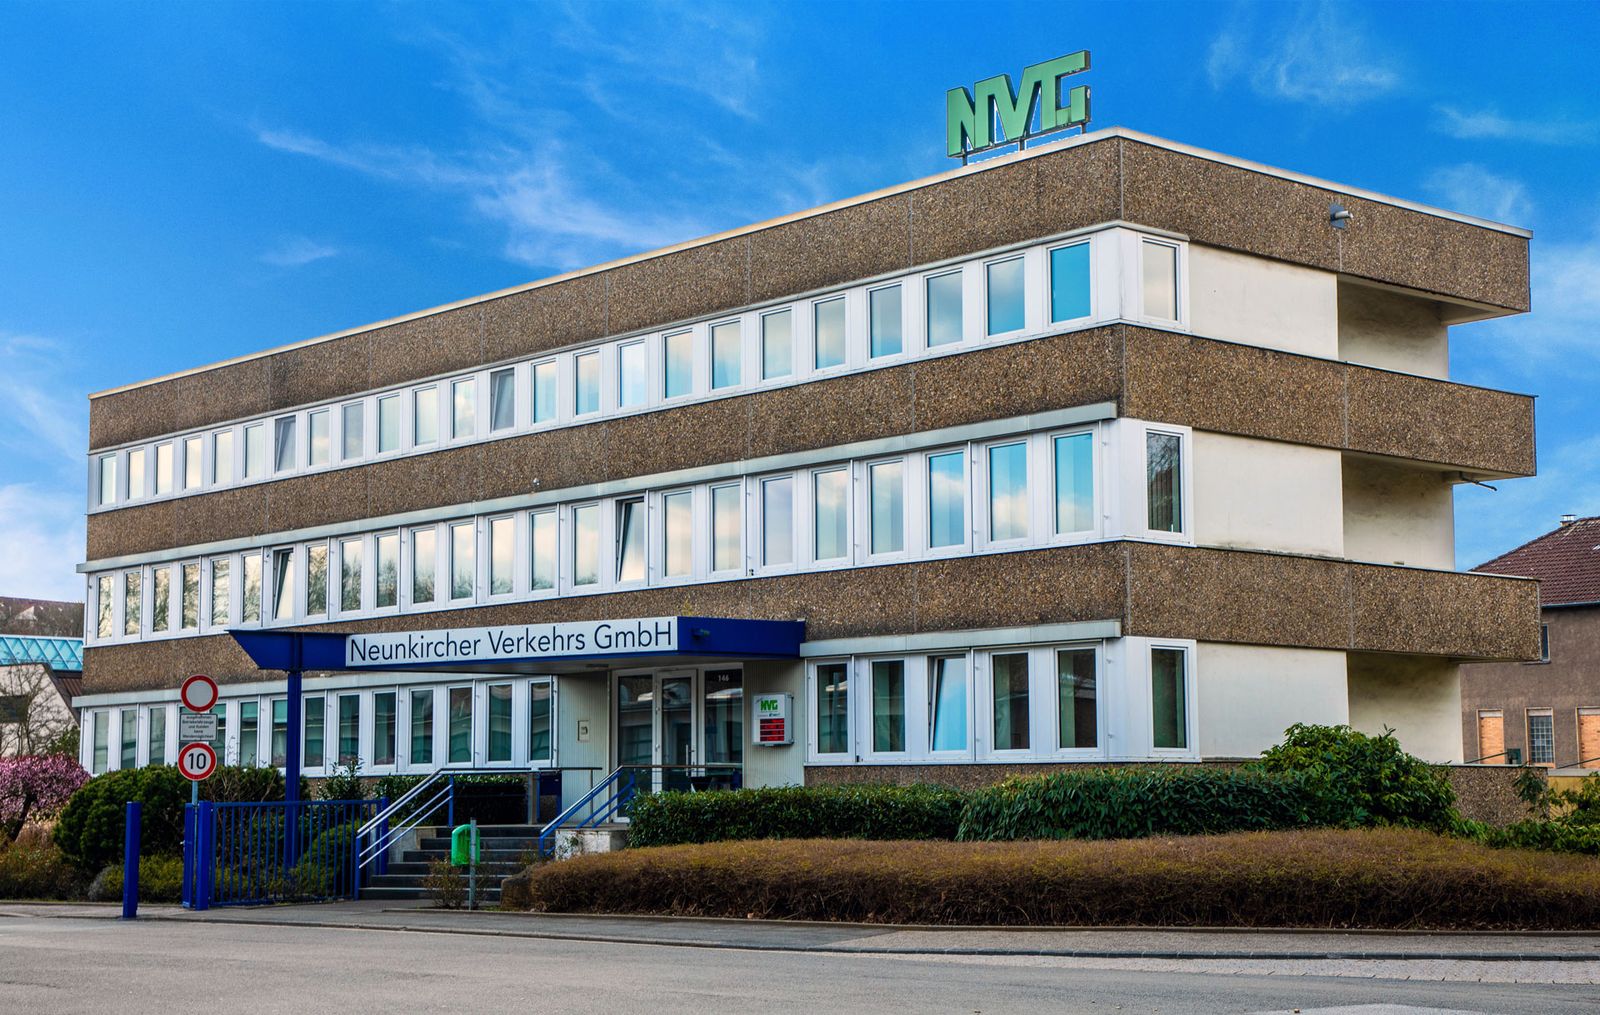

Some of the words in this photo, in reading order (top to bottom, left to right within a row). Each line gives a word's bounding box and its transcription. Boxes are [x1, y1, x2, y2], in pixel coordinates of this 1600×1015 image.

[947, 50, 1090, 157] NVG
[351, 632, 481, 662] Neunkircher
[488, 626, 585, 655] Verkehrs
[594, 621, 671, 649] GmbH
[188, 752, 207, 770] 10
